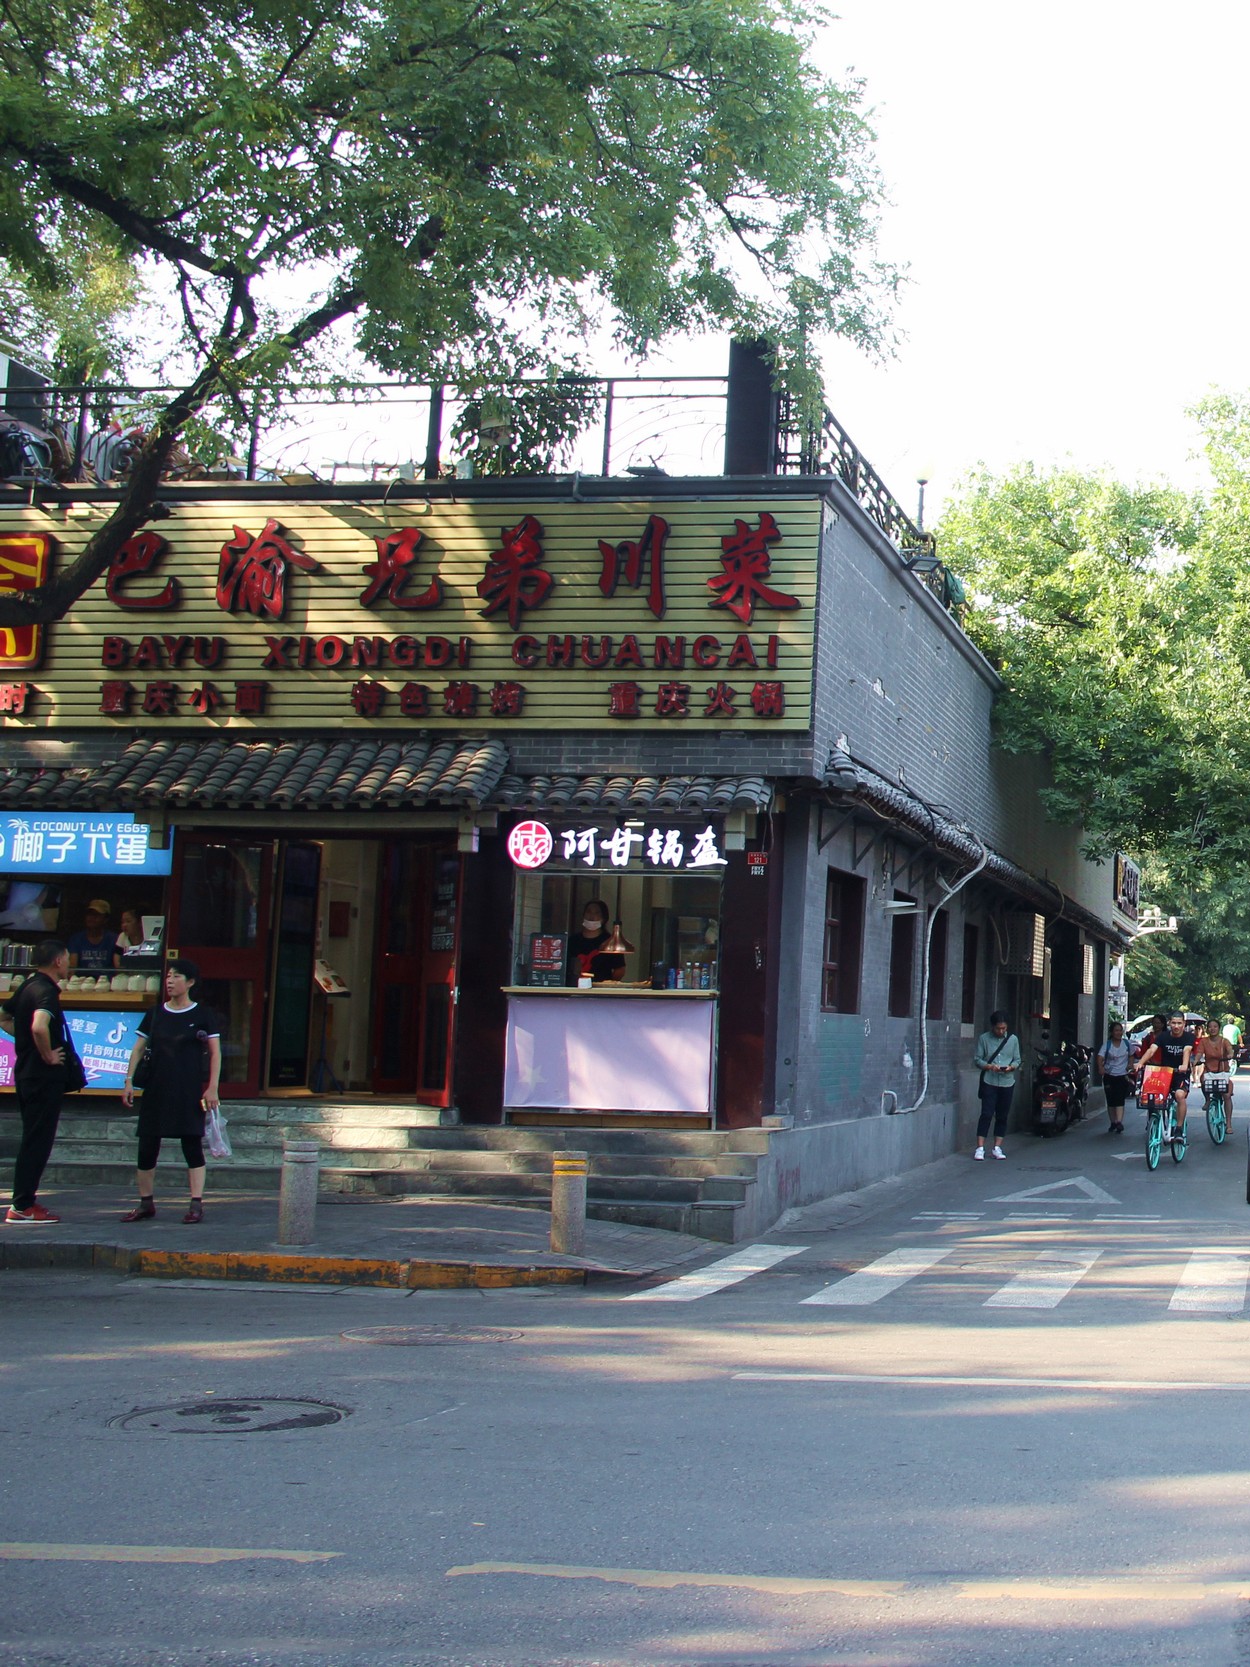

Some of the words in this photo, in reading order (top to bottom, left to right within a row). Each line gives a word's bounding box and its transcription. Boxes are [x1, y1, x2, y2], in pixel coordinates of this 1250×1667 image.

[105, 512, 800, 631] 巴渝兄弟川菜
[101, 636, 223, 668] BAYU
[260, 635, 472, 668] XIONGDI
[511, 635, 780, 668] CHUANCAI
[99, 681, 267, 714] 重庆小面
[351, 680, 526, 716] 特色烧烤
[607, 681, 785, 717] 重庆火锅
[33, 821, 87, 832] COCONUT
[90, 822, 113, 833] LAY
[117, 823, 148, 833] EGGS
[12, 832, 149, 865] 椰子下蛋
[560, 824, 729, 868] 阿甘锅盔
